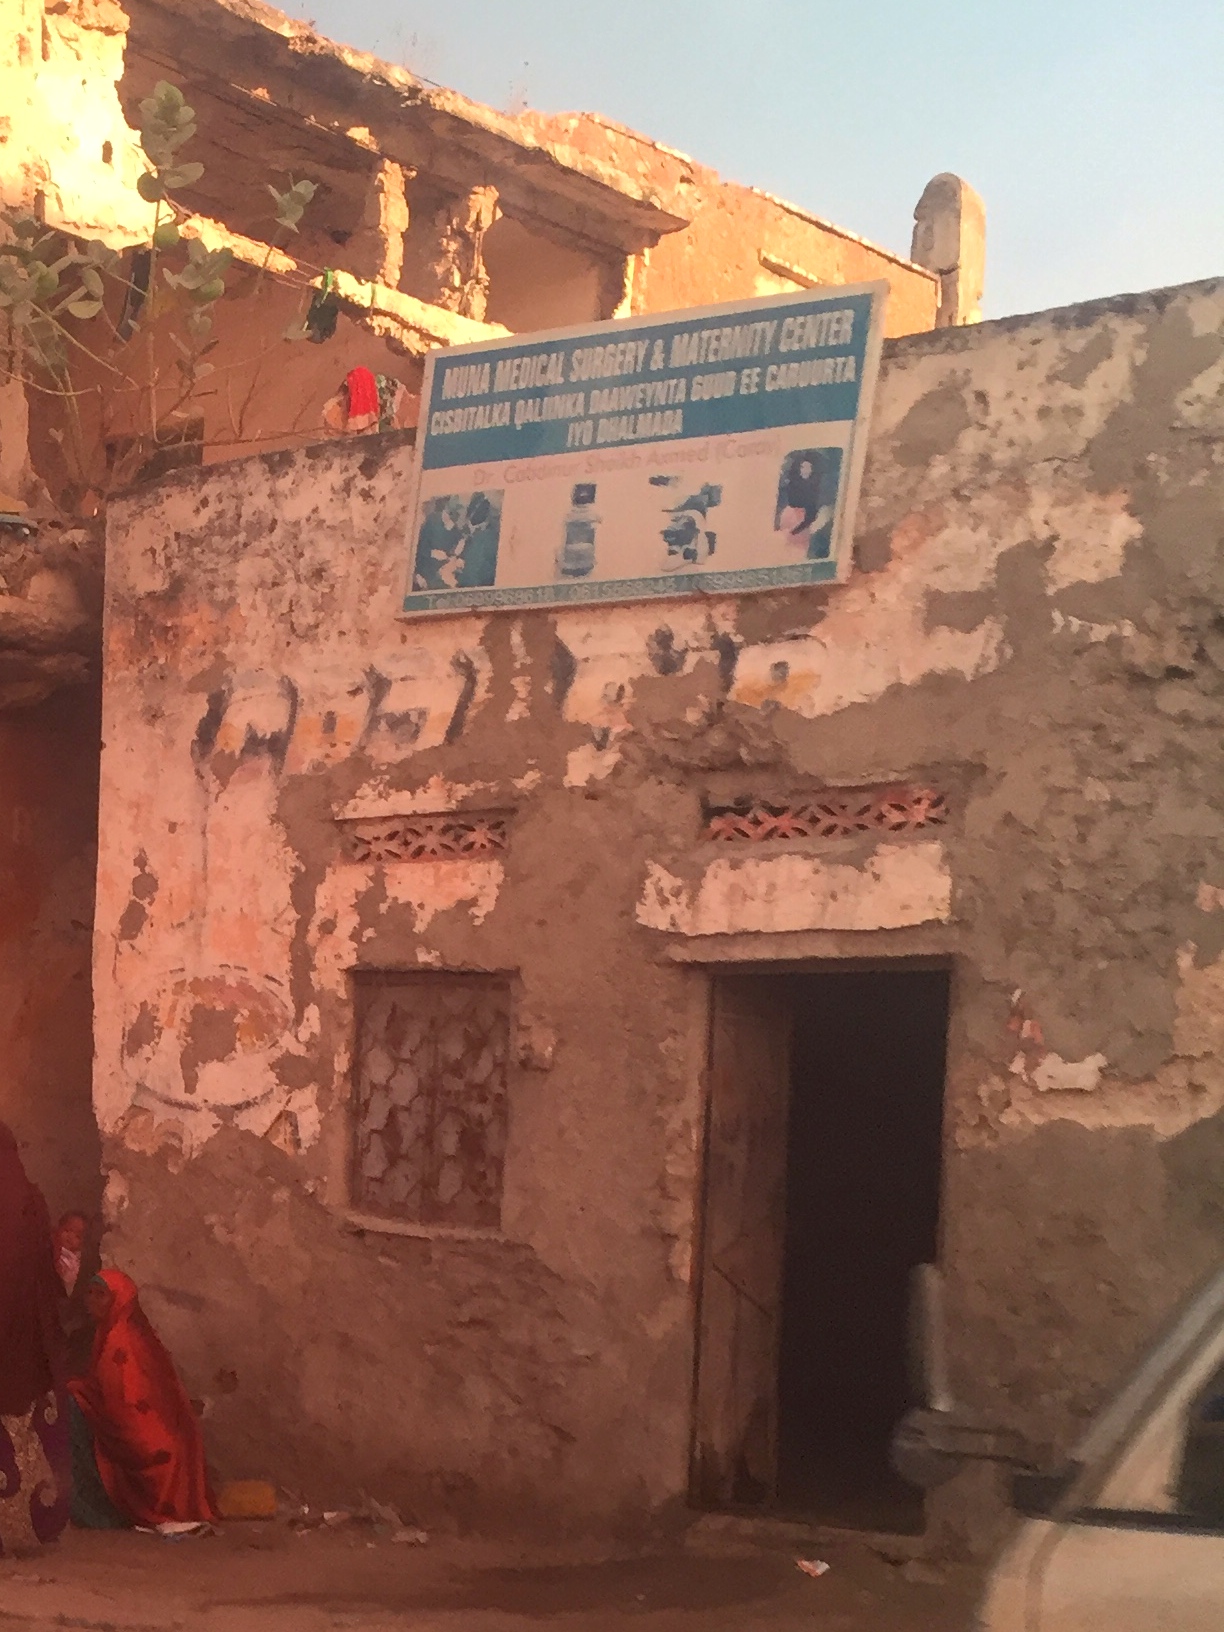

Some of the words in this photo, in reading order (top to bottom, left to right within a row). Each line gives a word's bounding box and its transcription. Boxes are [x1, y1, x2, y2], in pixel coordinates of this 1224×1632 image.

[442, 365, 490, 398] MUNA
[494, 353, 566, 391] MEDICAL
[570, 341, 648, 380] SURGERY
[650, 340, 665, 369] &
[669, 323, 776, 367] MATERNITY
[778, 311, 854, 352] CENTER
[739, 371, 759, 394] EE
[566, 422, 593, 446] IYO
